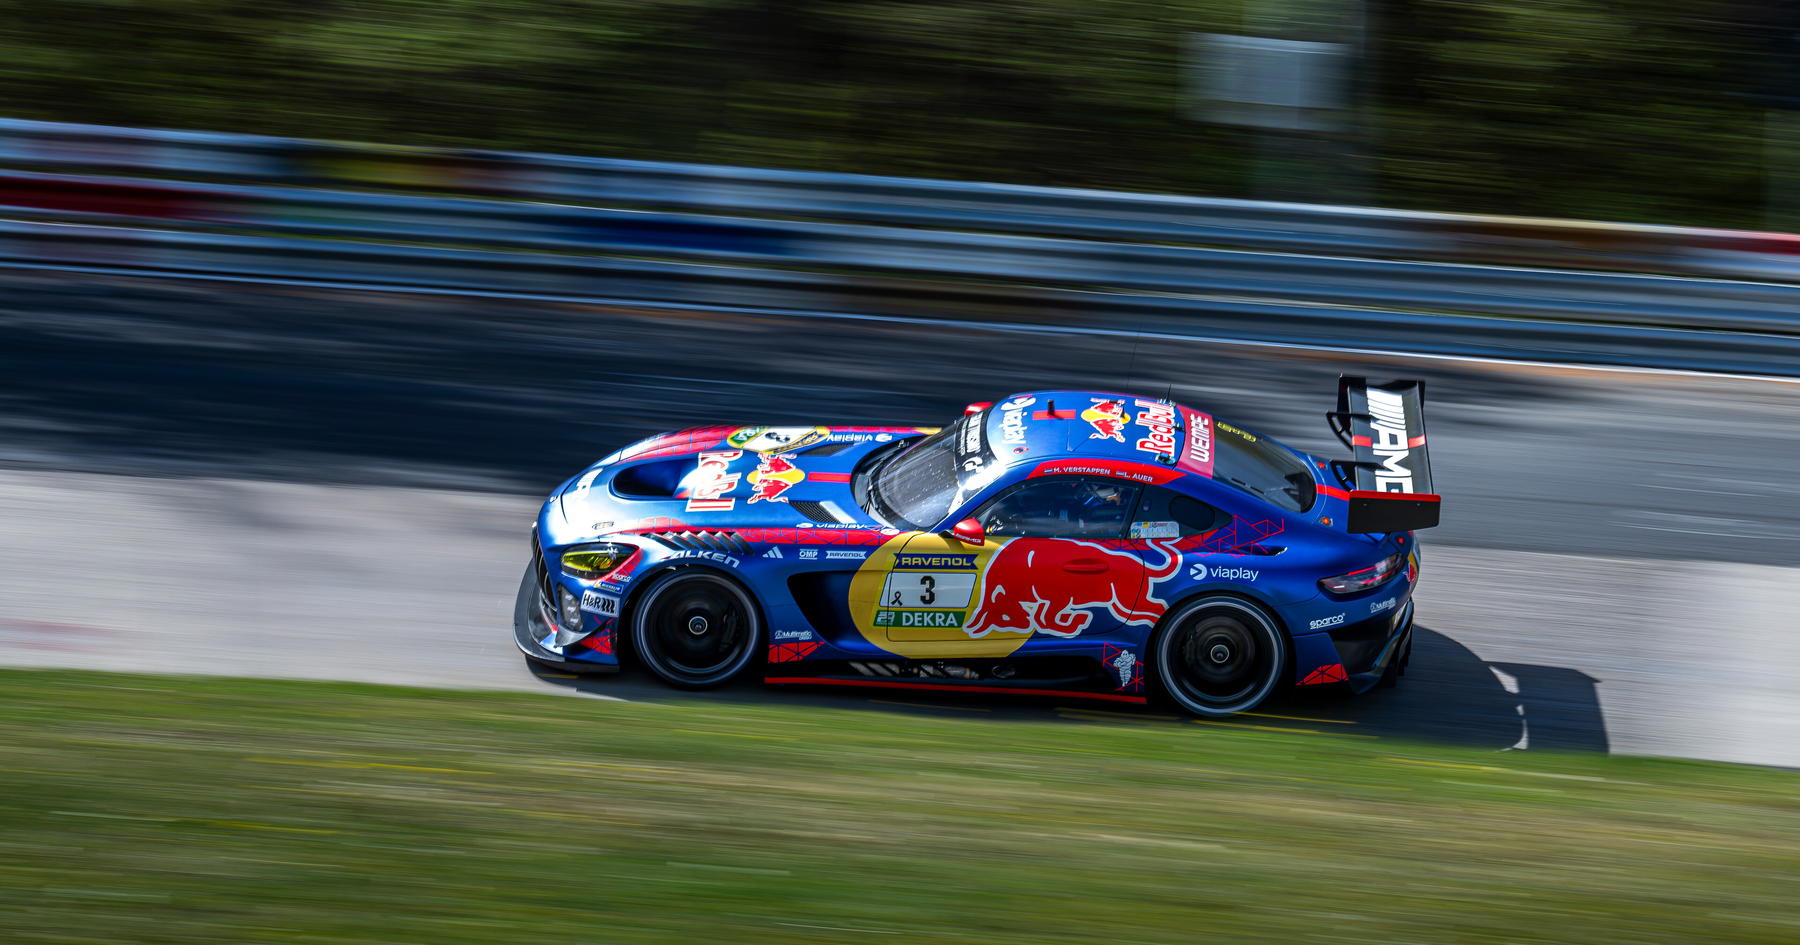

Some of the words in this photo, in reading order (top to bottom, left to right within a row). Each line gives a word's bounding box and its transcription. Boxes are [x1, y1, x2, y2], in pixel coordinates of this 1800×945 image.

[1063, 466, 1111, 475] VERSTAPPEN
[1132, 473, 1153, 482] AUER
[668, 550, 741, 568] ALKEN
[799, 550, 818, 559] OMP
[901, 557, 972, 566] RAVENOL
[1210, 566, 1259, 582] viaplay
[920, 575, 936, 605] 3
[902, 612, 958, 627] DEKRA
[1309, 614, 1344, 629] sparco
